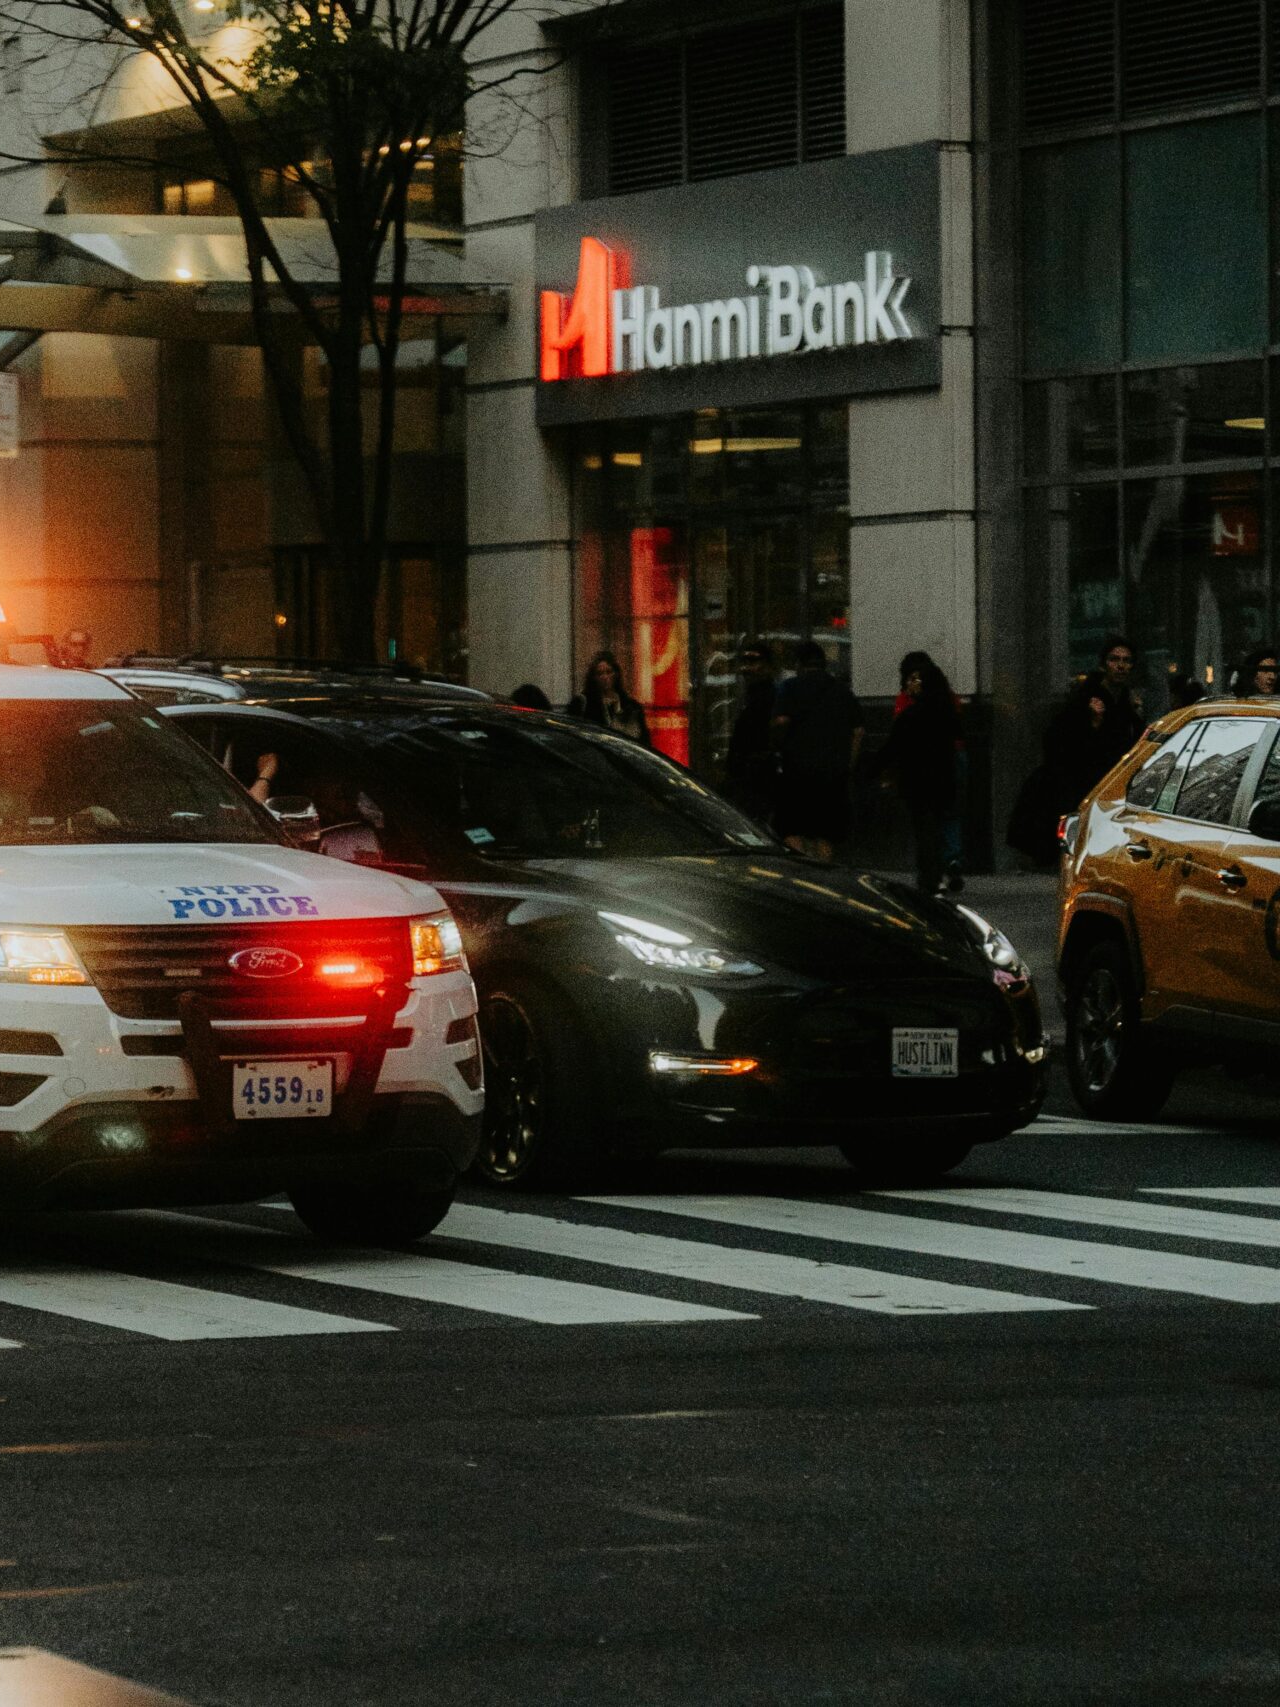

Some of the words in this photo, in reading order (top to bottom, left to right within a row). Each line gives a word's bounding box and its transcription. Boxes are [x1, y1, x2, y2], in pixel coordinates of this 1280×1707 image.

[613, 264, 761, 372] Hanmi
[770, 251, 910, 354] Bank
[175, 885, 279, 896] NYPD
[168, 896, 319, 919] POLICE
[248, 951, 287, 969] Ford
[898, 1042, 953, 1065] HUSTLINN
[241, 1076, 303, 1104] 4559
[306, 1089, 324, 1103] 18
